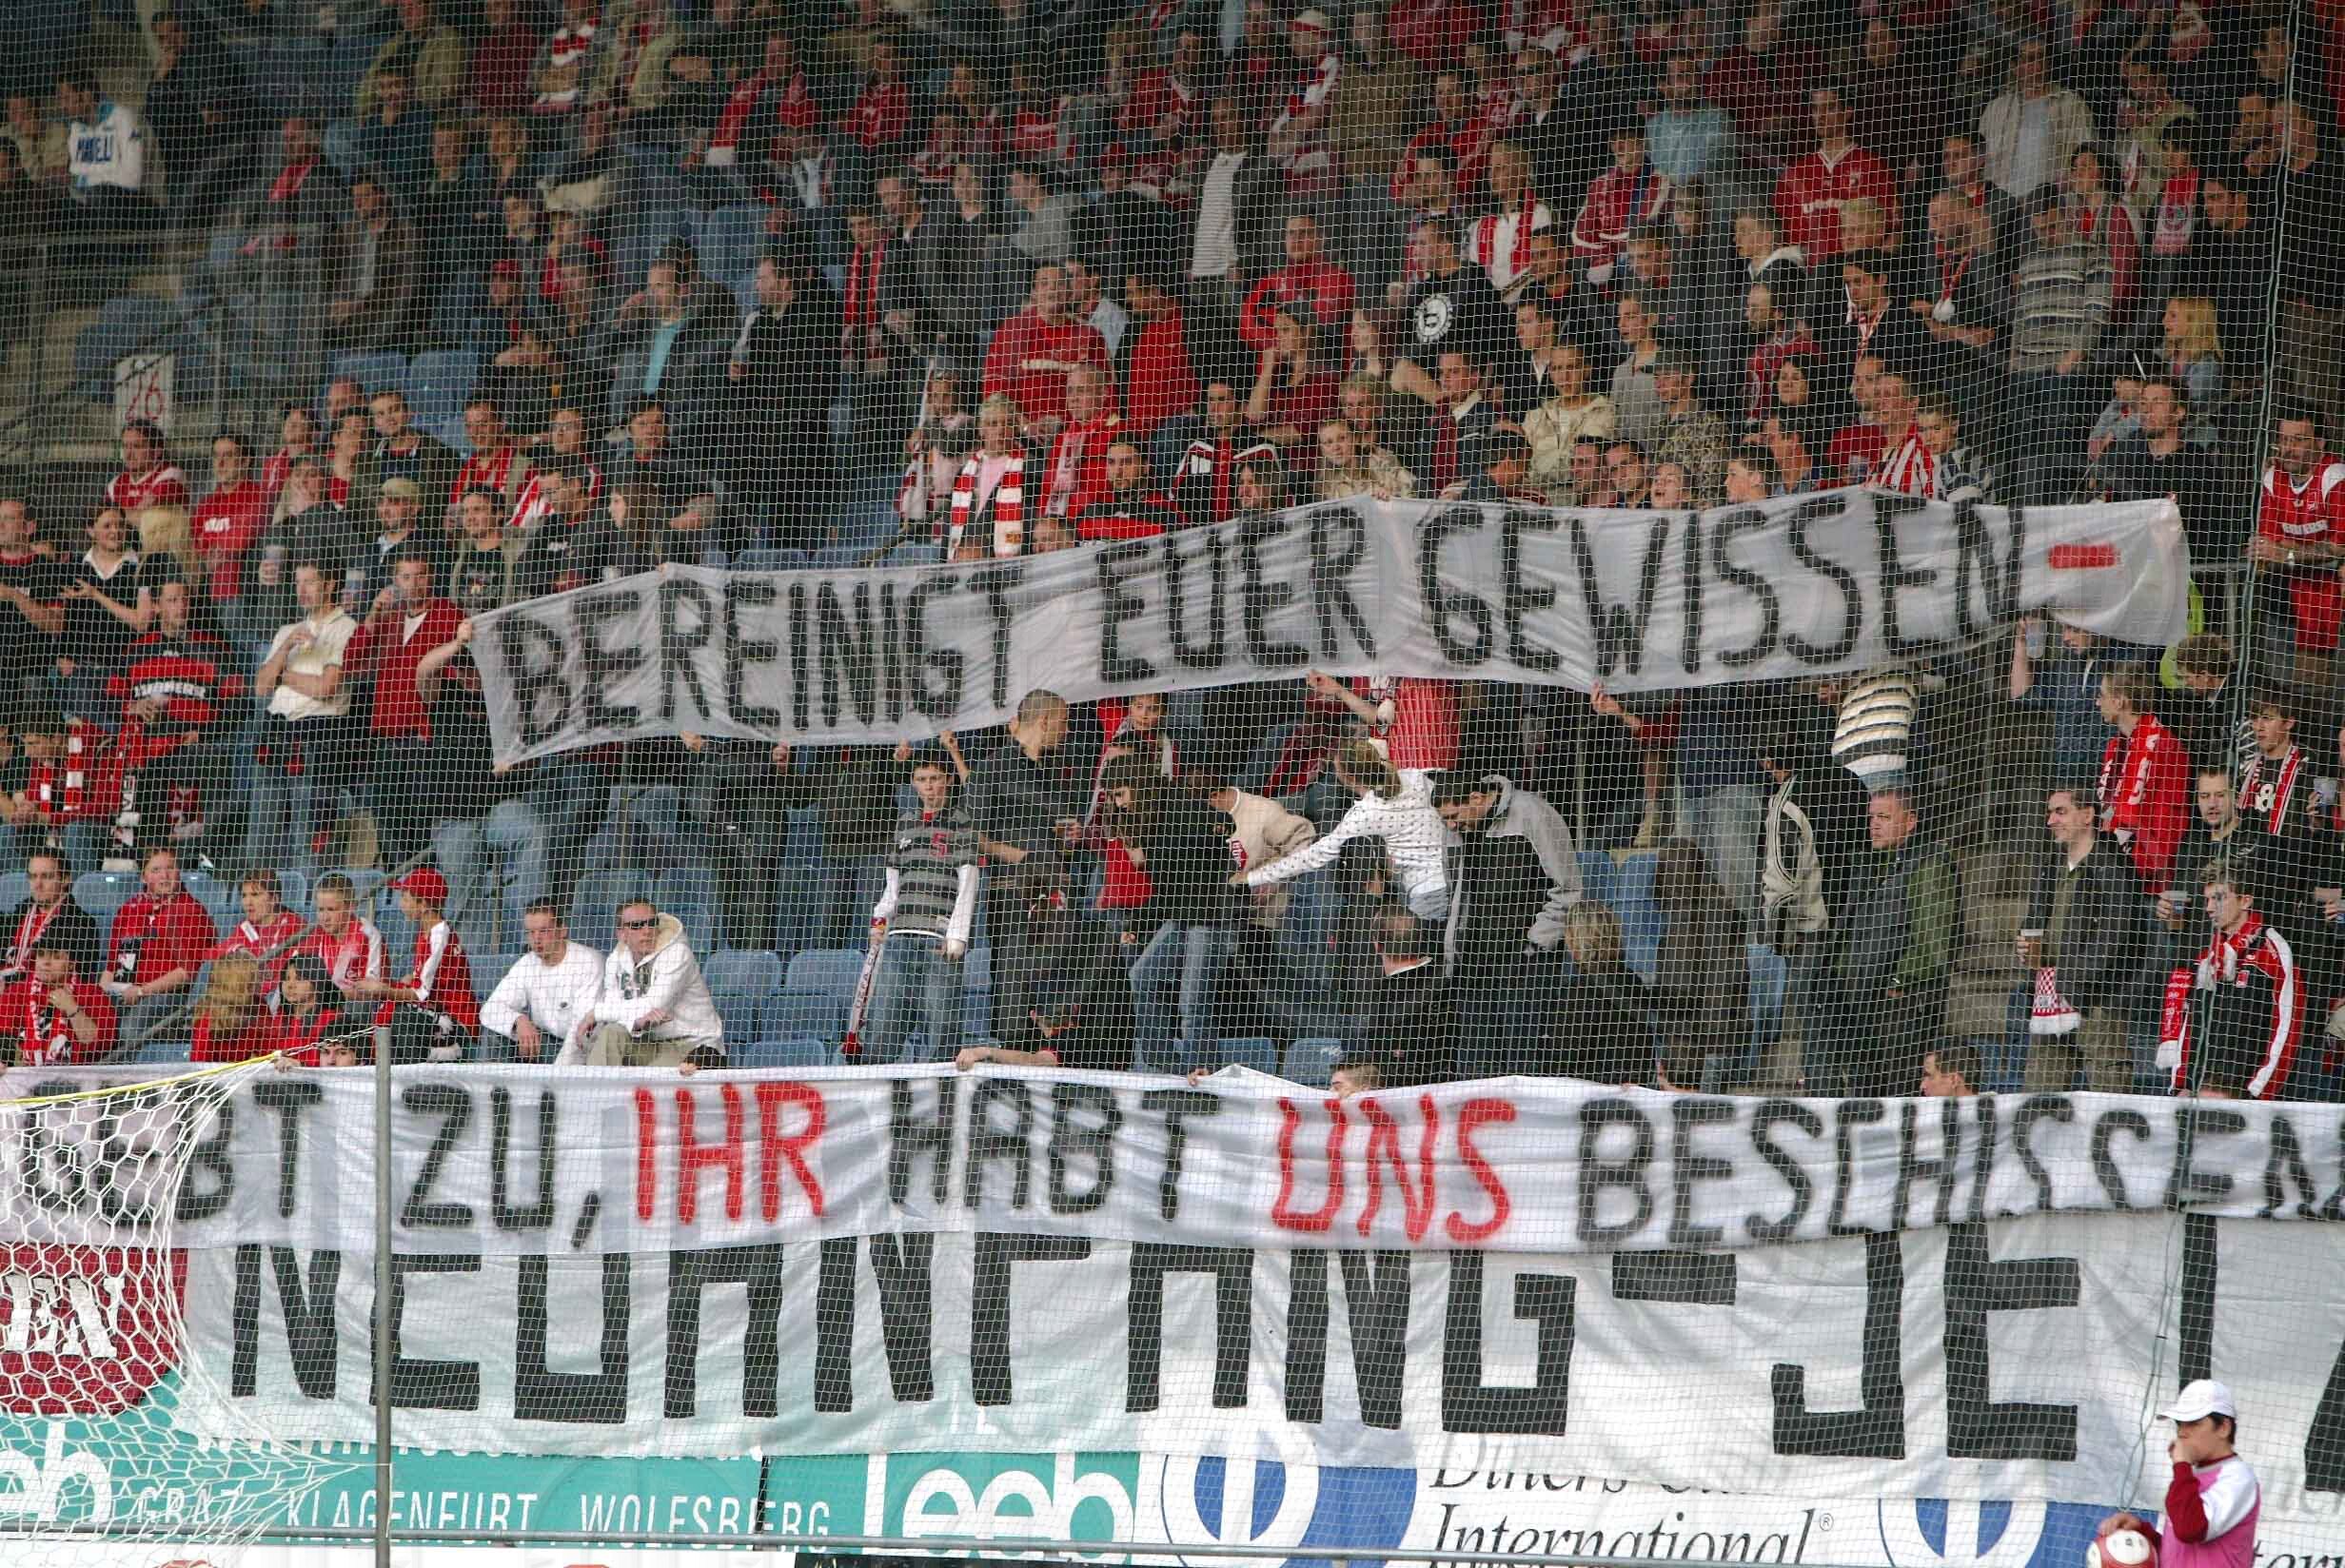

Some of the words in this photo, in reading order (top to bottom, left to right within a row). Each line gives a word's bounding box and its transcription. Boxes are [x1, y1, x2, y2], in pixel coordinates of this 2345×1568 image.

[494, 568, 1026, 747] BEREINIGT
[1096, 504, 1377, 682] EUER
[1417, 492, 2024, 676] GEWISSEN
[400, 1083, 601, 1249] ZU,
[634, 1081, 826, 1225] IHR
[889, 1077, 1221, 1223] HABT
[1270, 1094, 1518, 1243] UNS
